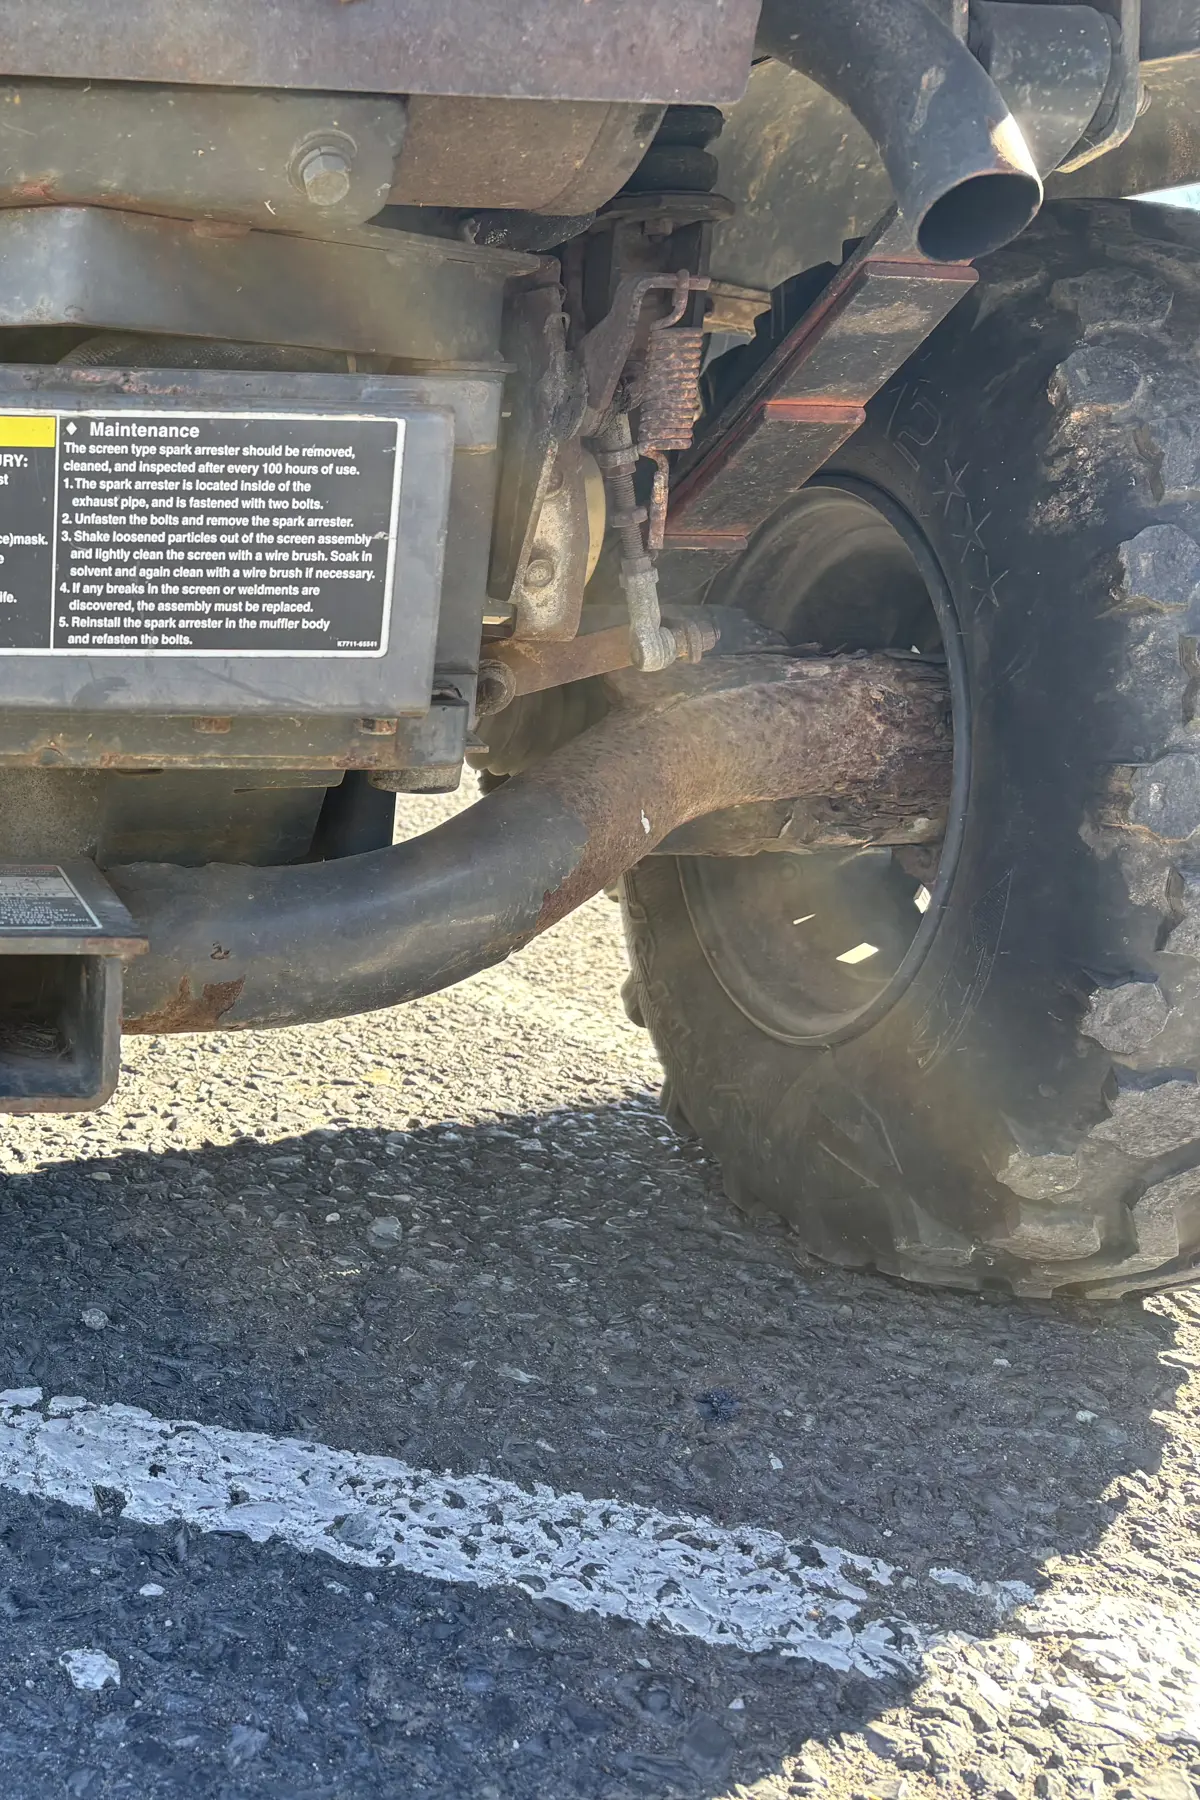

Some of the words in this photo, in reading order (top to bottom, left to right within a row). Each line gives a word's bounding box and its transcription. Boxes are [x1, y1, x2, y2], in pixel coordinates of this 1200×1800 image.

[90, 421, 199, 438] Maintenance
[63, 441, 86, 453] The
[88, 444, 128, 454] screen
[130, 443, 157, 457] type
[158, 443, 192, 457] spark
[194, 444, 240, 456] arrester
[242, 444, 282, 456] should
[284, 444, 299, 456] be
[301, 445, 355, 459] removed,
[63, 460, 112, 473] cleaned,
[113, 461, 136, 472] and
[138, 461, 195, 475] inspected
[197, 462, 225, 473] after
[226, 464, 259, 476] every
[262, 463, 282, 474] 100
[284, 463, 318, 474] hours
[320, 464, 333, 474] of
[335, 465, 359, 475] use.
[63, 477, 73, 489] 1.
[74, 477, 97, 489] The
[98, 478, 132, 492] spark
[134, 479, 180, 490] arrester
[182, 478, 193, 490] is
[195, 479, 238, 491] located
[240, 479, 275, 491] inside
[277, 480, 290, 491] of
[292, 480, 311, 492] the
[71, 495, 118, 507] exhaust
[120, 495, 149, 510] pipe,
[150, 496, 173, 507] and
[175, 496, 186, 508] is
[188, 496, 239, 508] fastened
[240, 497, 265, 508] with
[267, 498, 289, 509] two
[291, 498, 323, 509] bolts.
[61, 512, 72, 524] 2.
[74, 512, 126, 525] Unfasten
[128, 513, 147, 525] the
[150, 513, 179, 525] bolts
[181, 514, 203, 525] and
[206, 516, 249, 526] remove
[251, 514, 270, 526] the
[272, 515, 305, 529] spark
[306, 516, 353, 527] arrester.
[60, 530, 71, 541] 3.
[73, 529, 110, 542] Shake
[112, 530, 165, 542] loosened
[167, 531, 217, 545] particles
[219, 532, 239, 543] out
[240, 531, 253, 543] of
[255, 532, 274, 543] the
[276, 534, 315, 544] screen
[317, 533, 371, 547] assembly
[69, 565, 112, 576] solvent
[114, 565, 136, 577] and
[138, 565, 170, 579] again
[172, 566, 203, 577] clean
[206, 566, 230, 577] with
[232, 568, 240, 578] a
[242, 566, 267, 578] wire
[269, 566, 302, 578] brush
[304, 567, 313, 578] if
[315, 569, 375, 581] necessary.
[59, 582, 70, 593] 4.
[72, 581, 80, 593] If
[82, 584, 103, 596] any
[106, 582, 144, 594] breaks
[147, 582, 158, 594] in
[160, 582, 179, 594] the
[181, 585, 220, 594] screen
[222, 585, 236, 595] or
[237, 583, 299, 595] weldments
[300, 586, 320, 595] are
[68, 599, 134, 612] discovered,
[136, 599, 155, 611] the
[157, 600, 212, 614] assembly
[214, 601, 242, 612] must
[244, 601, 259, 612] be
[261, 601, 313, 614] replaced.
[67, 633, 89, 644] and
[91, 633, 138, 644] refasten
[140, 633, 159, 644] the
[160, 633, 192, 645] bolts.
